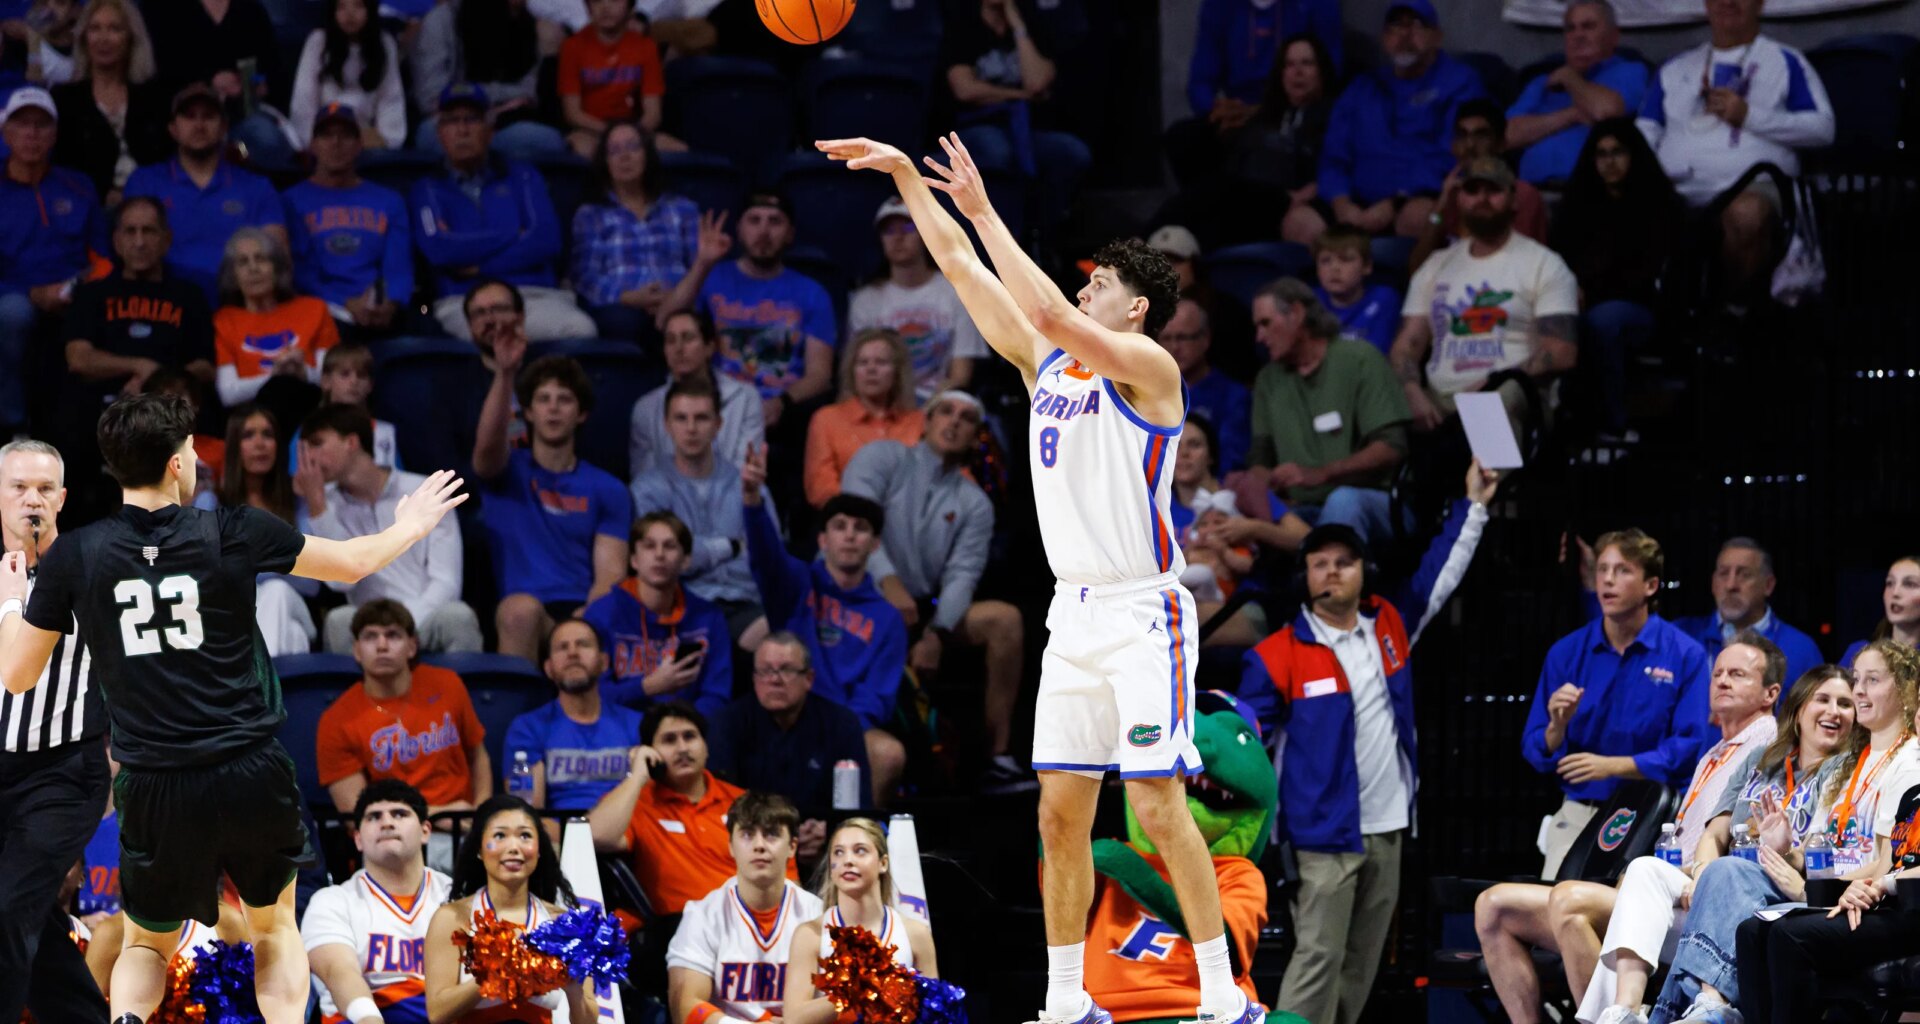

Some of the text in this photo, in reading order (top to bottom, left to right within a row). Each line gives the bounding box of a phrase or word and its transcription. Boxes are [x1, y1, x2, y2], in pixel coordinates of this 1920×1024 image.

[1040, 426, 1060, 469] 8
[113, 574, 204, 657] 23
[1080, 586, 1089, 603] F
[369, 711, 459, 771] Florida
[552, 754, 631, 776] FLORID
[366, 933, 426, 975] FLOR
[1106, 911, 1182, 961] F
[720, 962, 789, 1002] FLORI
